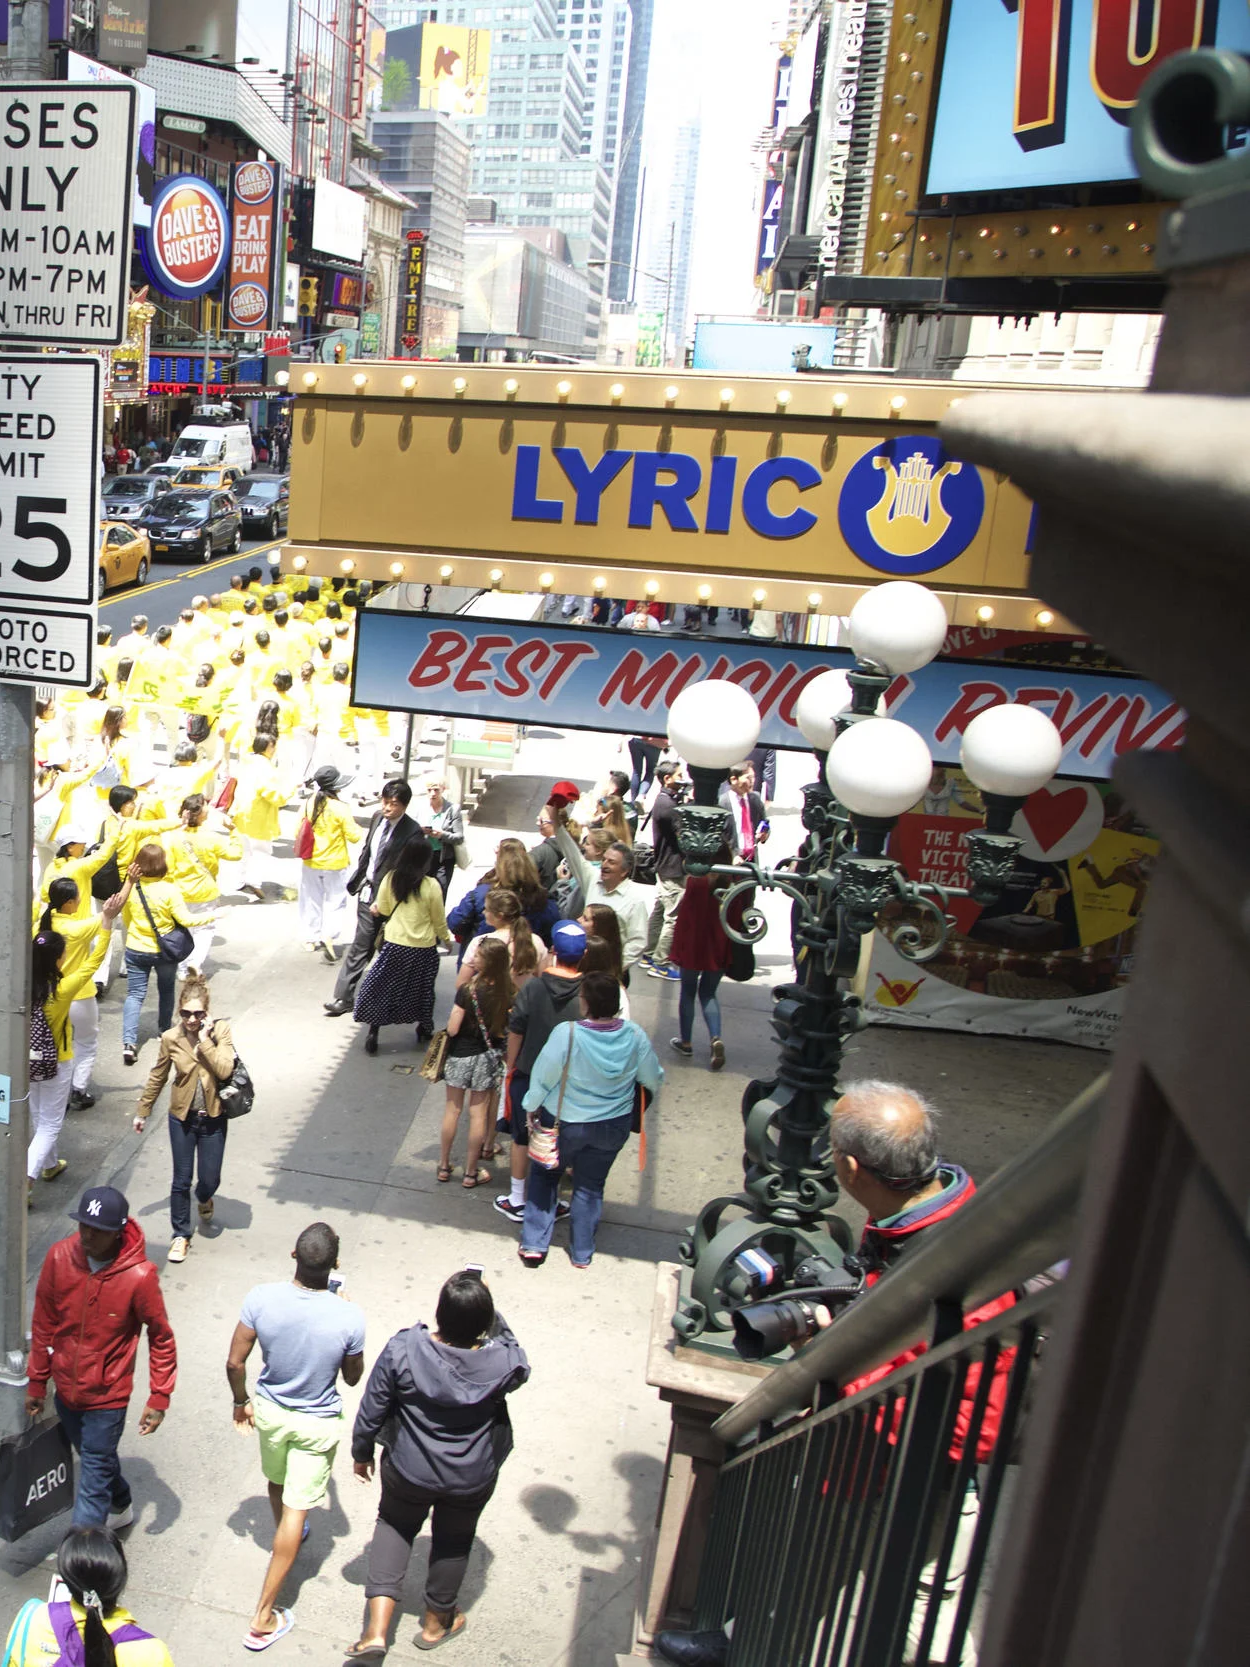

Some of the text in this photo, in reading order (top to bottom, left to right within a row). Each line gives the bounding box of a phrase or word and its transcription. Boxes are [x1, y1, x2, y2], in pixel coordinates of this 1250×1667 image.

[238, 168, 269, 186] DAVE &
[239, 179, 271, 196] BUSTER'S
[161, 204, 218, 242] DAVE &
[235, 215, 270, 240] EAT
[163, 231, 219, 267] BUSTER'S
[233, 240, 268, 255] DRINK
[233, 255, 268, 274] PLAY
[407, 246, 422, 331] EMPIRE
[232, 292, 255, 308] DAVE
[14, 304, 65, 325] THRU
[76, 304, 112, 328] FRI
[511, 444, 823, 540] LYRIC
[407, 630, 596, 701] BEST
[923, 829, 954, 847] THE
[921, 848, 970, 868] VICT
[918, 868, 971, 888] THEAT
[1066, 1004, 1123, 1021] NewVict
[25, 1461, 67, 1508] AERO
